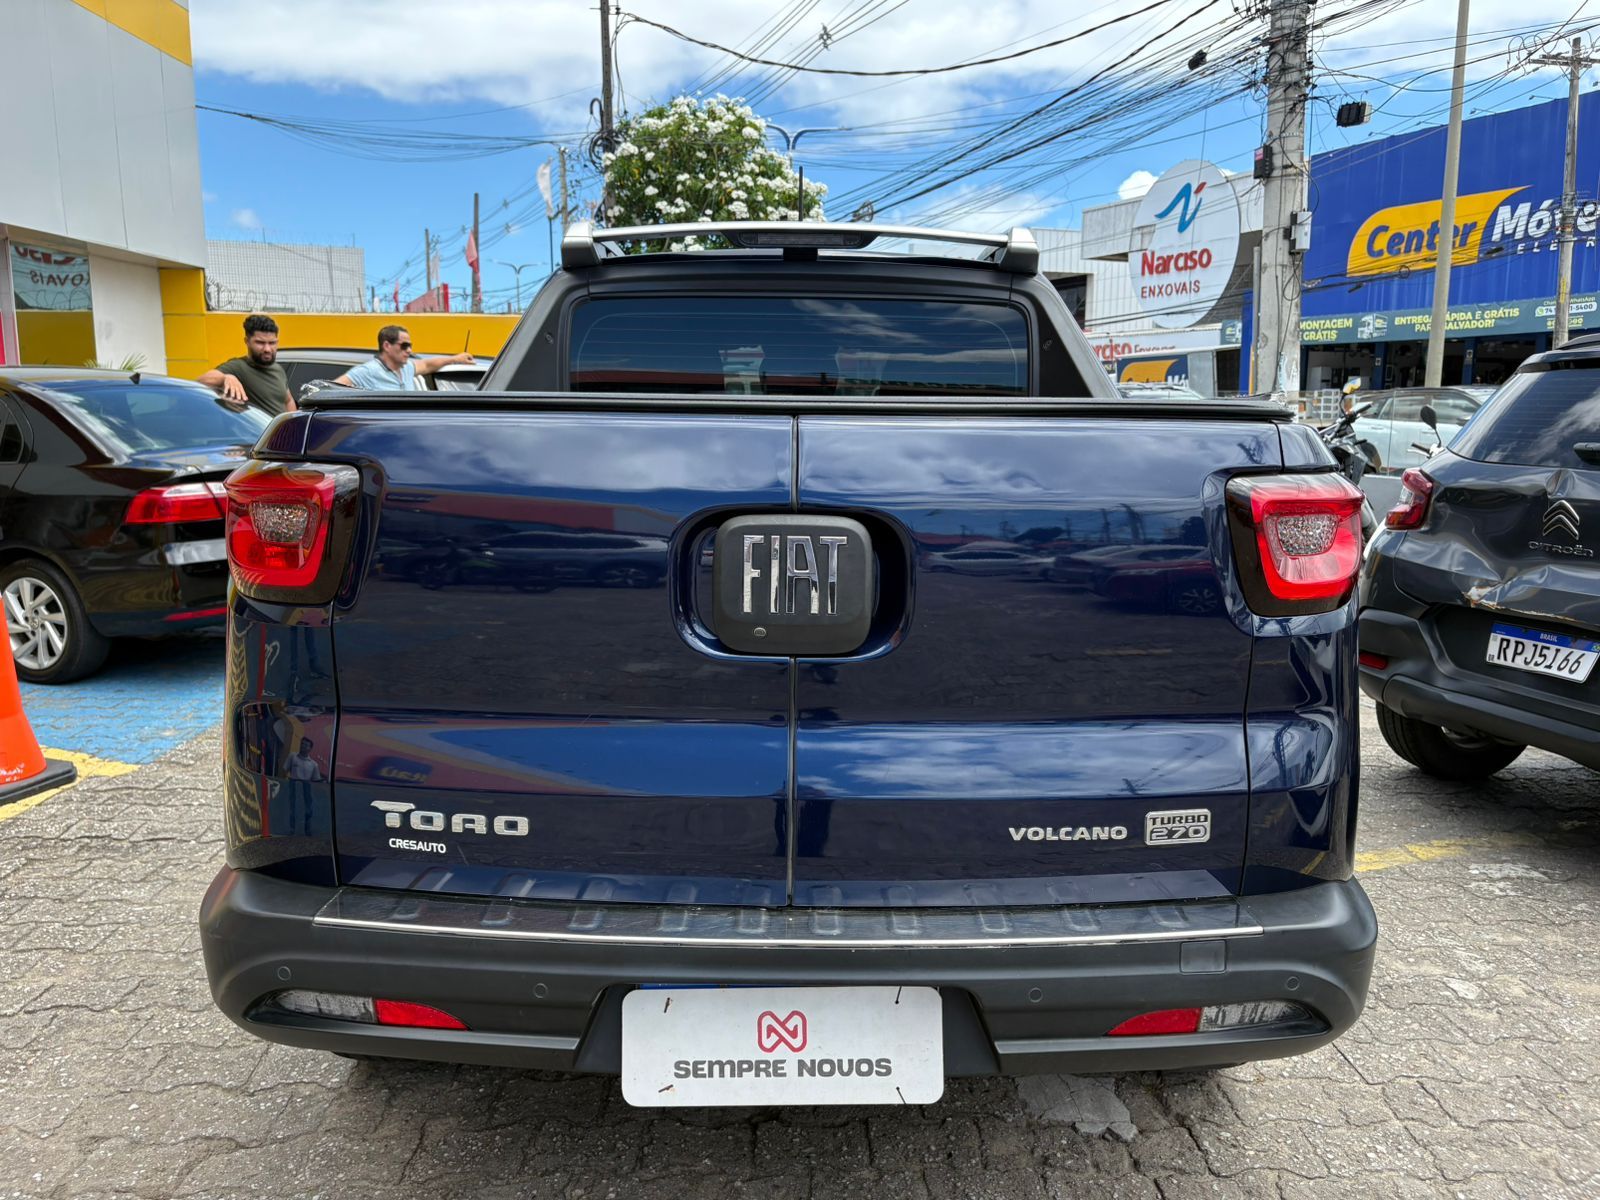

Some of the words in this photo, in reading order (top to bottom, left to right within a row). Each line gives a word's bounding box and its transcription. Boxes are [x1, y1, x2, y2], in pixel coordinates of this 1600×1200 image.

[1141, 248, 1212, 277] Narciso
[1140, 279, 1201, 299] ENXOVAIS
[1445, 311, 1472, 321] ÁPIDA
[1475, 310, 1482, 319] E
[1484, 307, 1520, 319] GRÁTIS
[1303, 328, 1338, 341] GRÁTIS
[743, 535, 848, 615] FIAT
[370, 800, 529, 836] TORO
[1150, 814, 1209, 826] TURBO
[1009, 826, 1128, 841] VOLCANO
[1151, 825, 1208, 840] 270
[389, 838, 446, 853] CRESAUTO
[673, 1058, 788, 1079] SEMPRE
[797, 1058, 893, 1078] NOVOS
